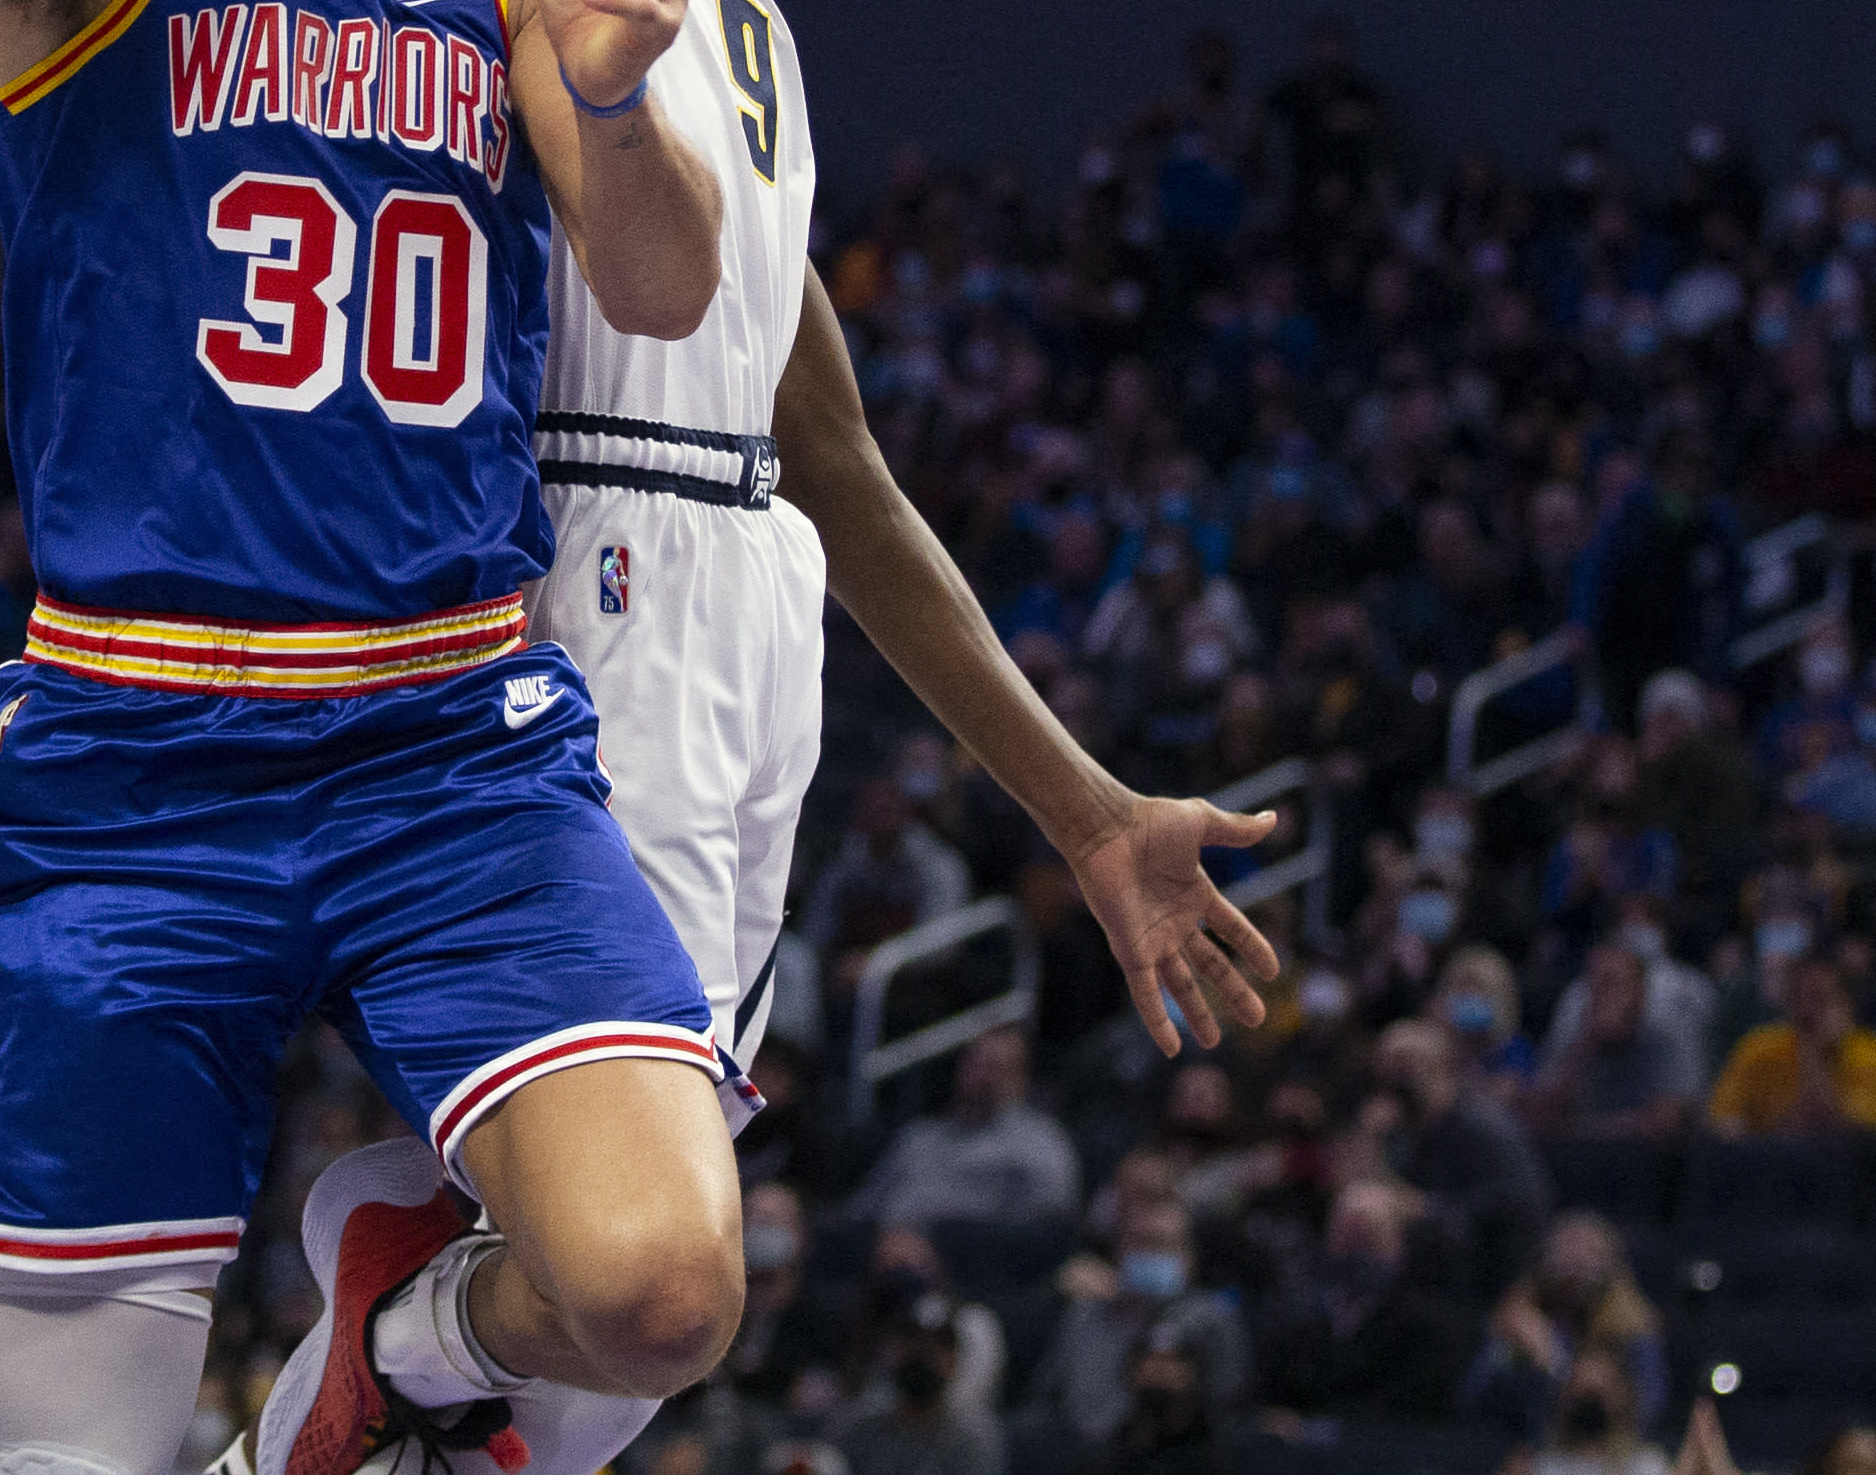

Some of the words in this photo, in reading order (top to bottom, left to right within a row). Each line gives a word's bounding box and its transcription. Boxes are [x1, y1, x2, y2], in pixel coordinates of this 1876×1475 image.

[168, 3, 512, 194] WARRIORS
[196, 171, 488, 428] 30
[505, 676, 550, 706] NIKE
